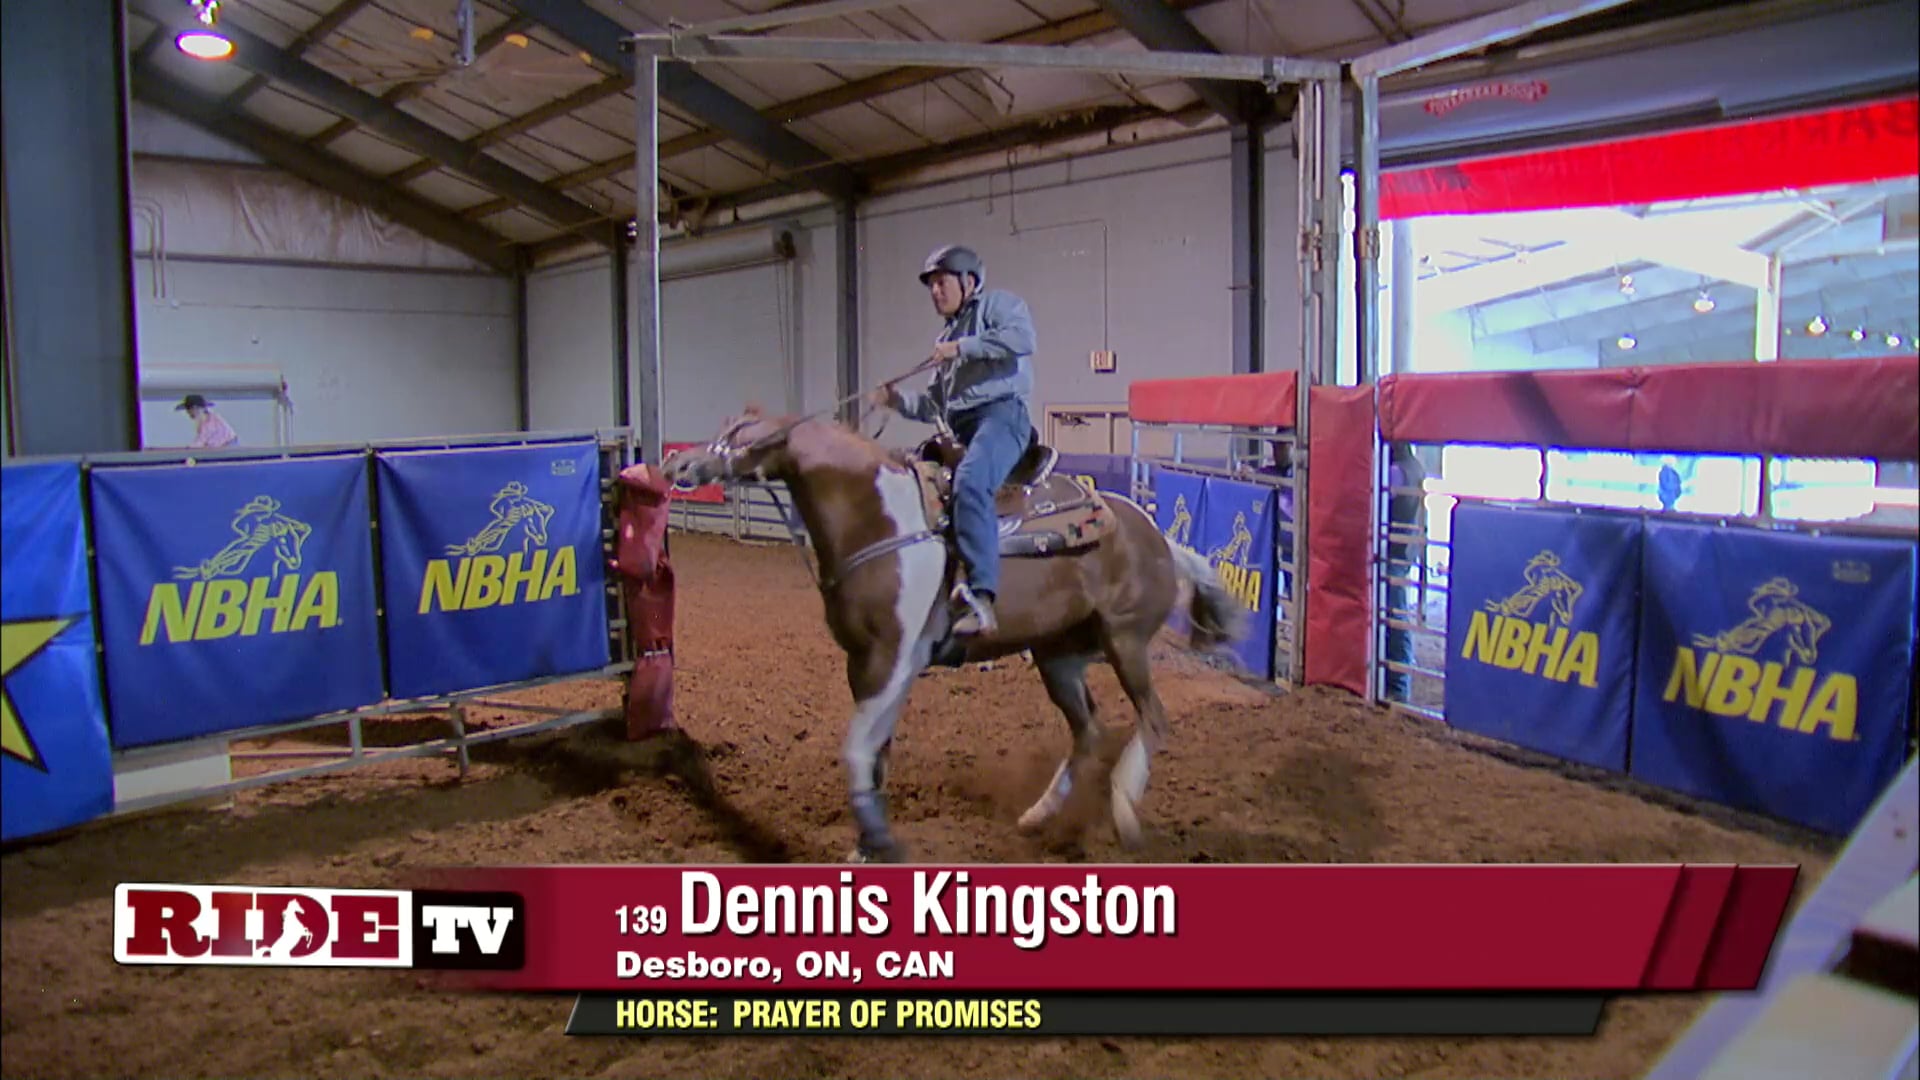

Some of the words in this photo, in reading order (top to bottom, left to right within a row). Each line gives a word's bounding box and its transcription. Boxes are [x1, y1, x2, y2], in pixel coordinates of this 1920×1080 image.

[139, 571, 340, 645] NBHA
[418, 545, 577, 614] NBHA
[1461, 610, 1599, 688] NBHA
[1663, 646, 1860, 742] NBHA
